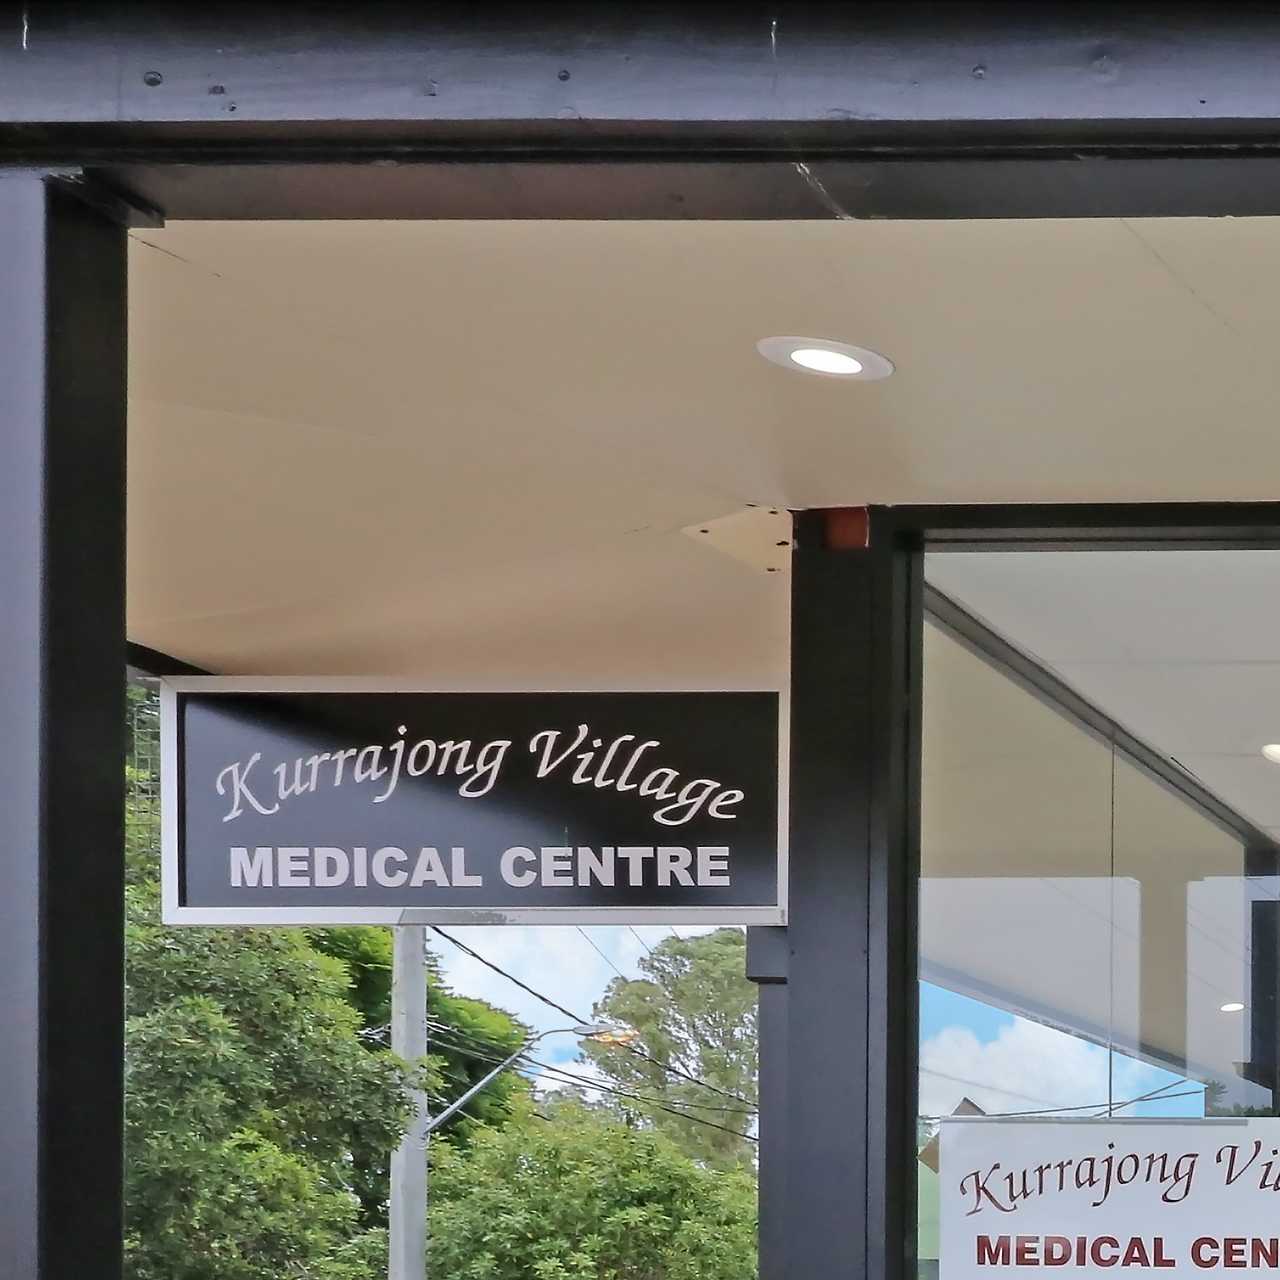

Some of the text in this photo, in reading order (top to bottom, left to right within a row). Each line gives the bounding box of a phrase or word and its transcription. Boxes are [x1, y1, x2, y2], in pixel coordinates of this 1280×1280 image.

[215, 724, 745, 826] Kurrajong Village
[230, 846, 730, 888] MEDICAL CENTRE
[959, 1143, 1199, 1216] Kurrajong
[976, 1235, 1176, 1268] MEDICAL
